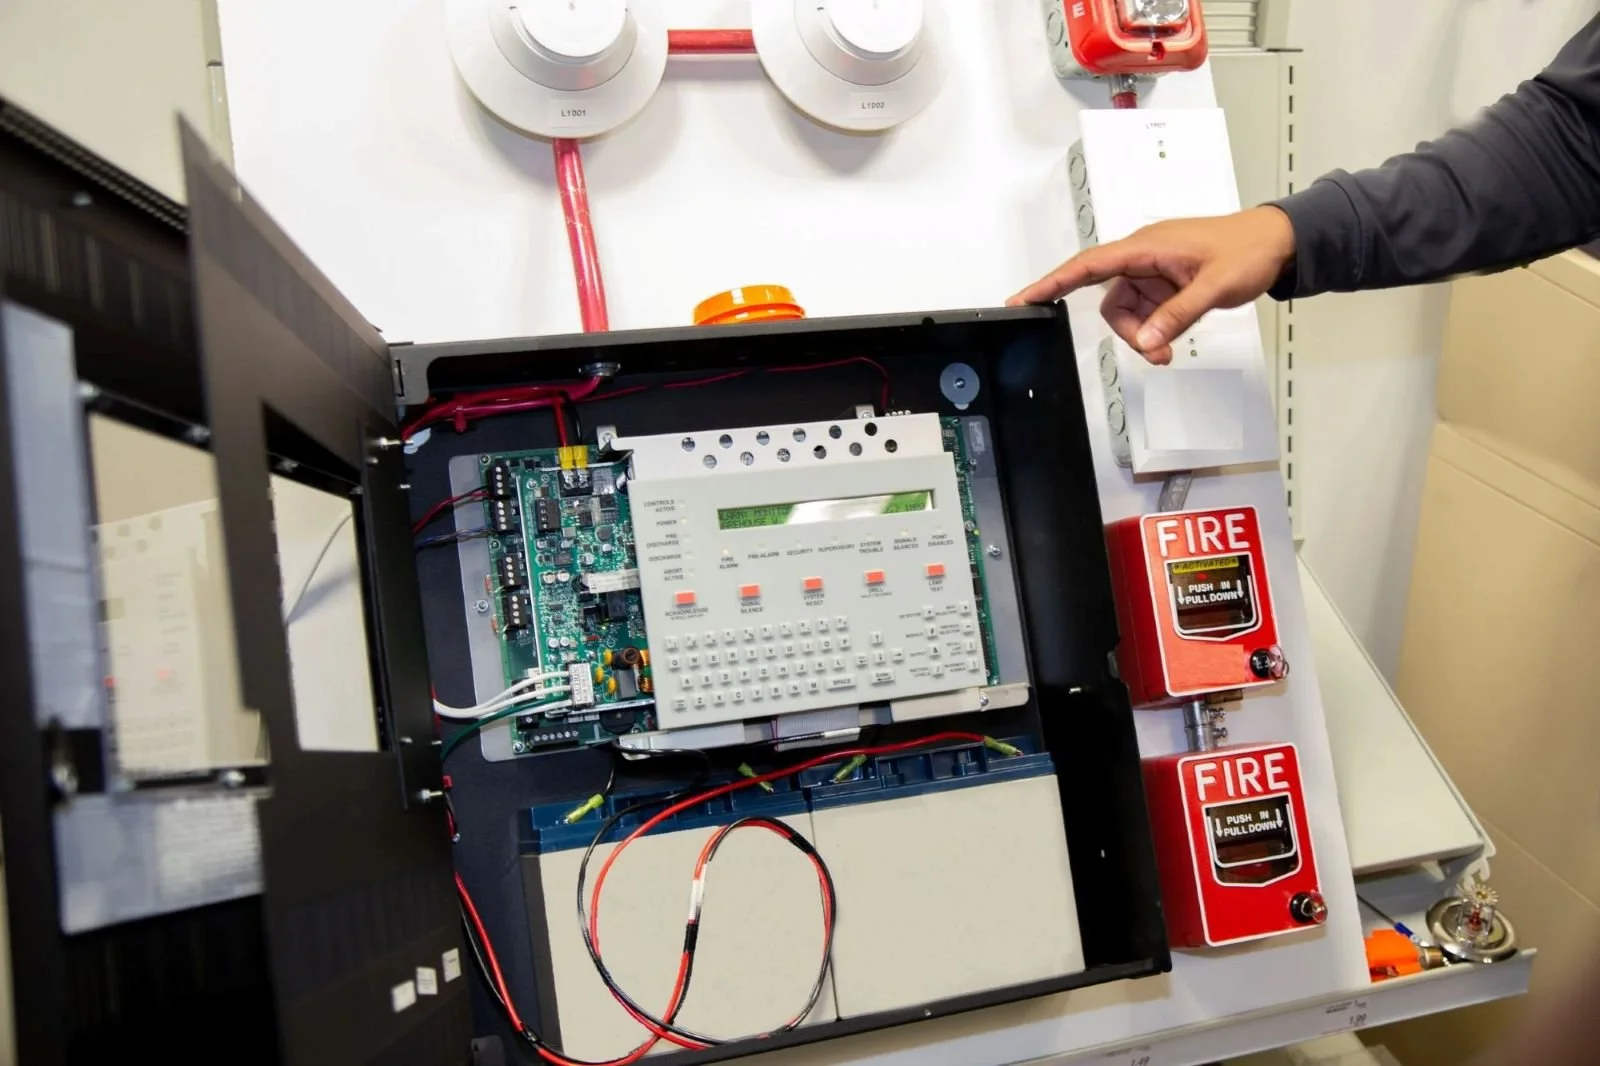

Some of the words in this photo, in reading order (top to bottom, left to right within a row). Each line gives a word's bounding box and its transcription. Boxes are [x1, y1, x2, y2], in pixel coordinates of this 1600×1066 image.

[1156, 512, 1250, 557] FIRE
[786, 548, 813, 556] SECURITY
[1188, 582, 1214, 594] PUSH
[1220, 581, 1231, 590] IN
[1185, 593, 1210, 605] PULL
[1210, 591, 1238, 603] DOWN
[832, 678, 852, 686] SPACE
[1194, 752, 1290, 801] FIRE
[1226, 813, 1253, 825] PUSH
[1260, 810, 1270, 820] IN
[1223, 825, 1249, 837] PULL
[1249, 820, 1277, 834] DOWN
